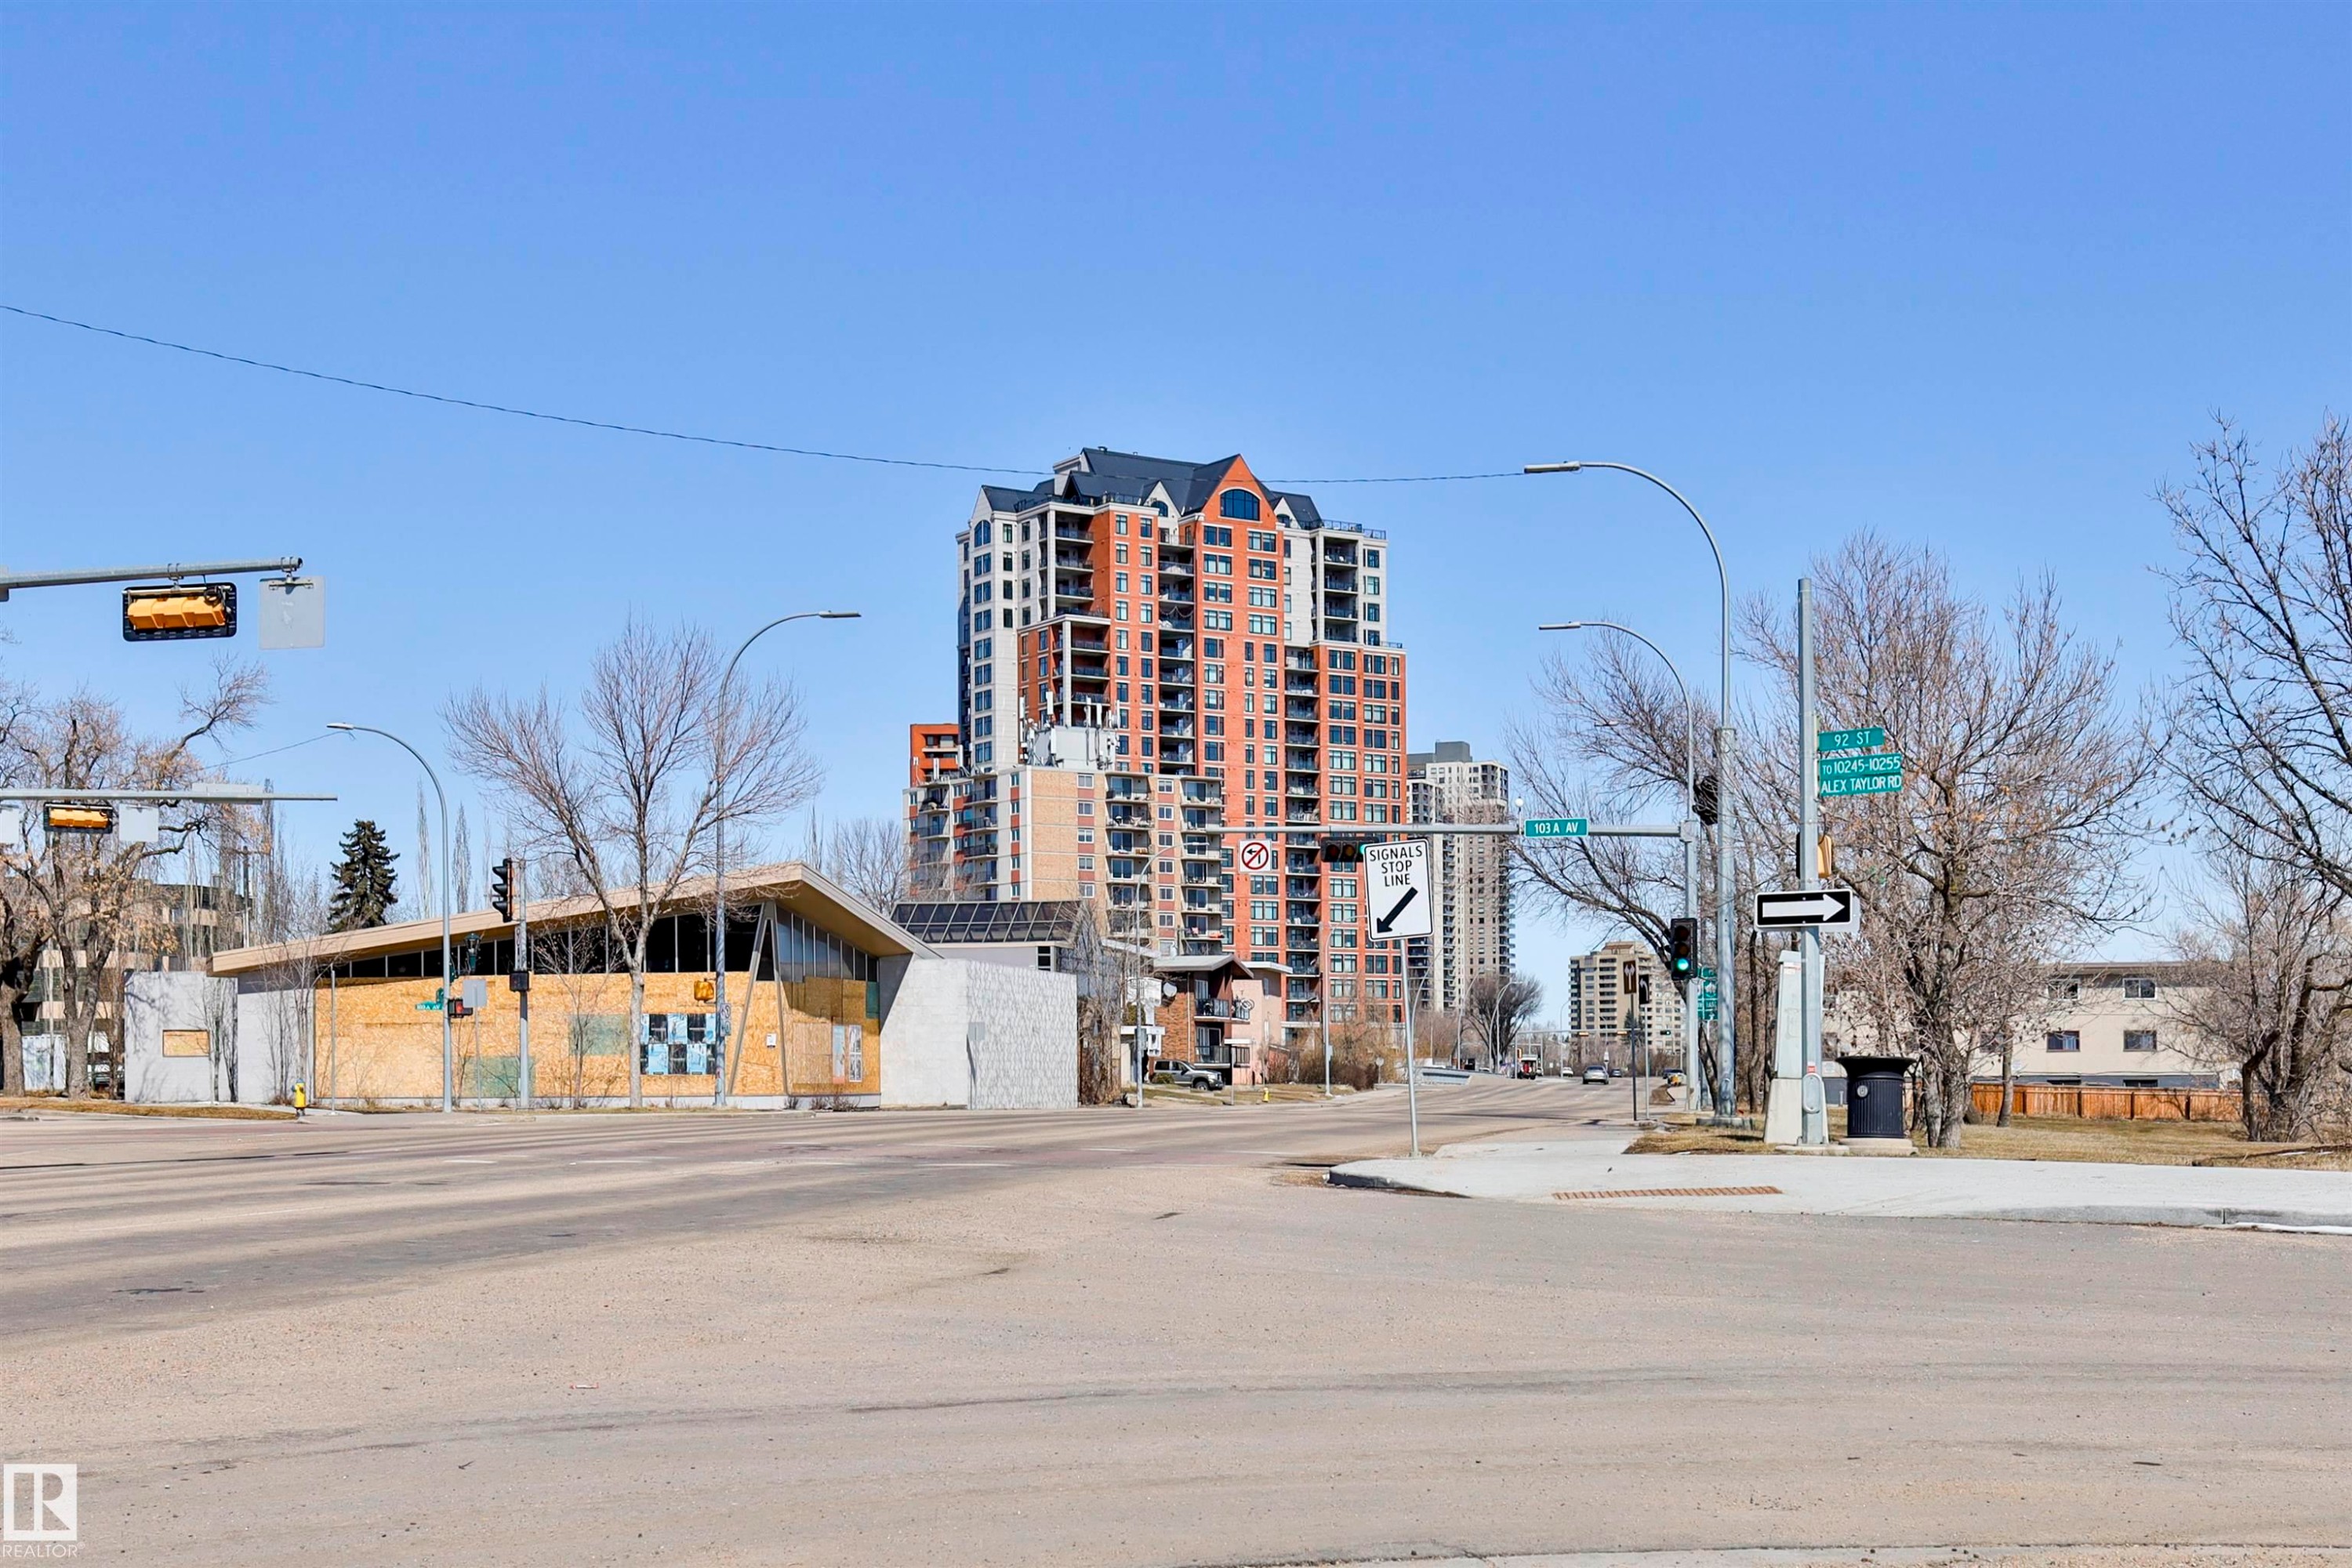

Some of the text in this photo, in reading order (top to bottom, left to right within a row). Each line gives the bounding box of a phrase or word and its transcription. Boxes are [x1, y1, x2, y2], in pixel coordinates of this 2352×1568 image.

[1835, 731, 1871, 746] 92 ST
[1823, 756, 1901, 775] TO 10245-10255
[1821, 775, 1901, 793] ALEX TAYLOR RD
[1566, 822, 1578, 833] AV
[1370, 845, 1422, 862] SIGNALS
[1381, 859, 1412, 874] STOP
[1385, 873, 1410, 887] LINE
